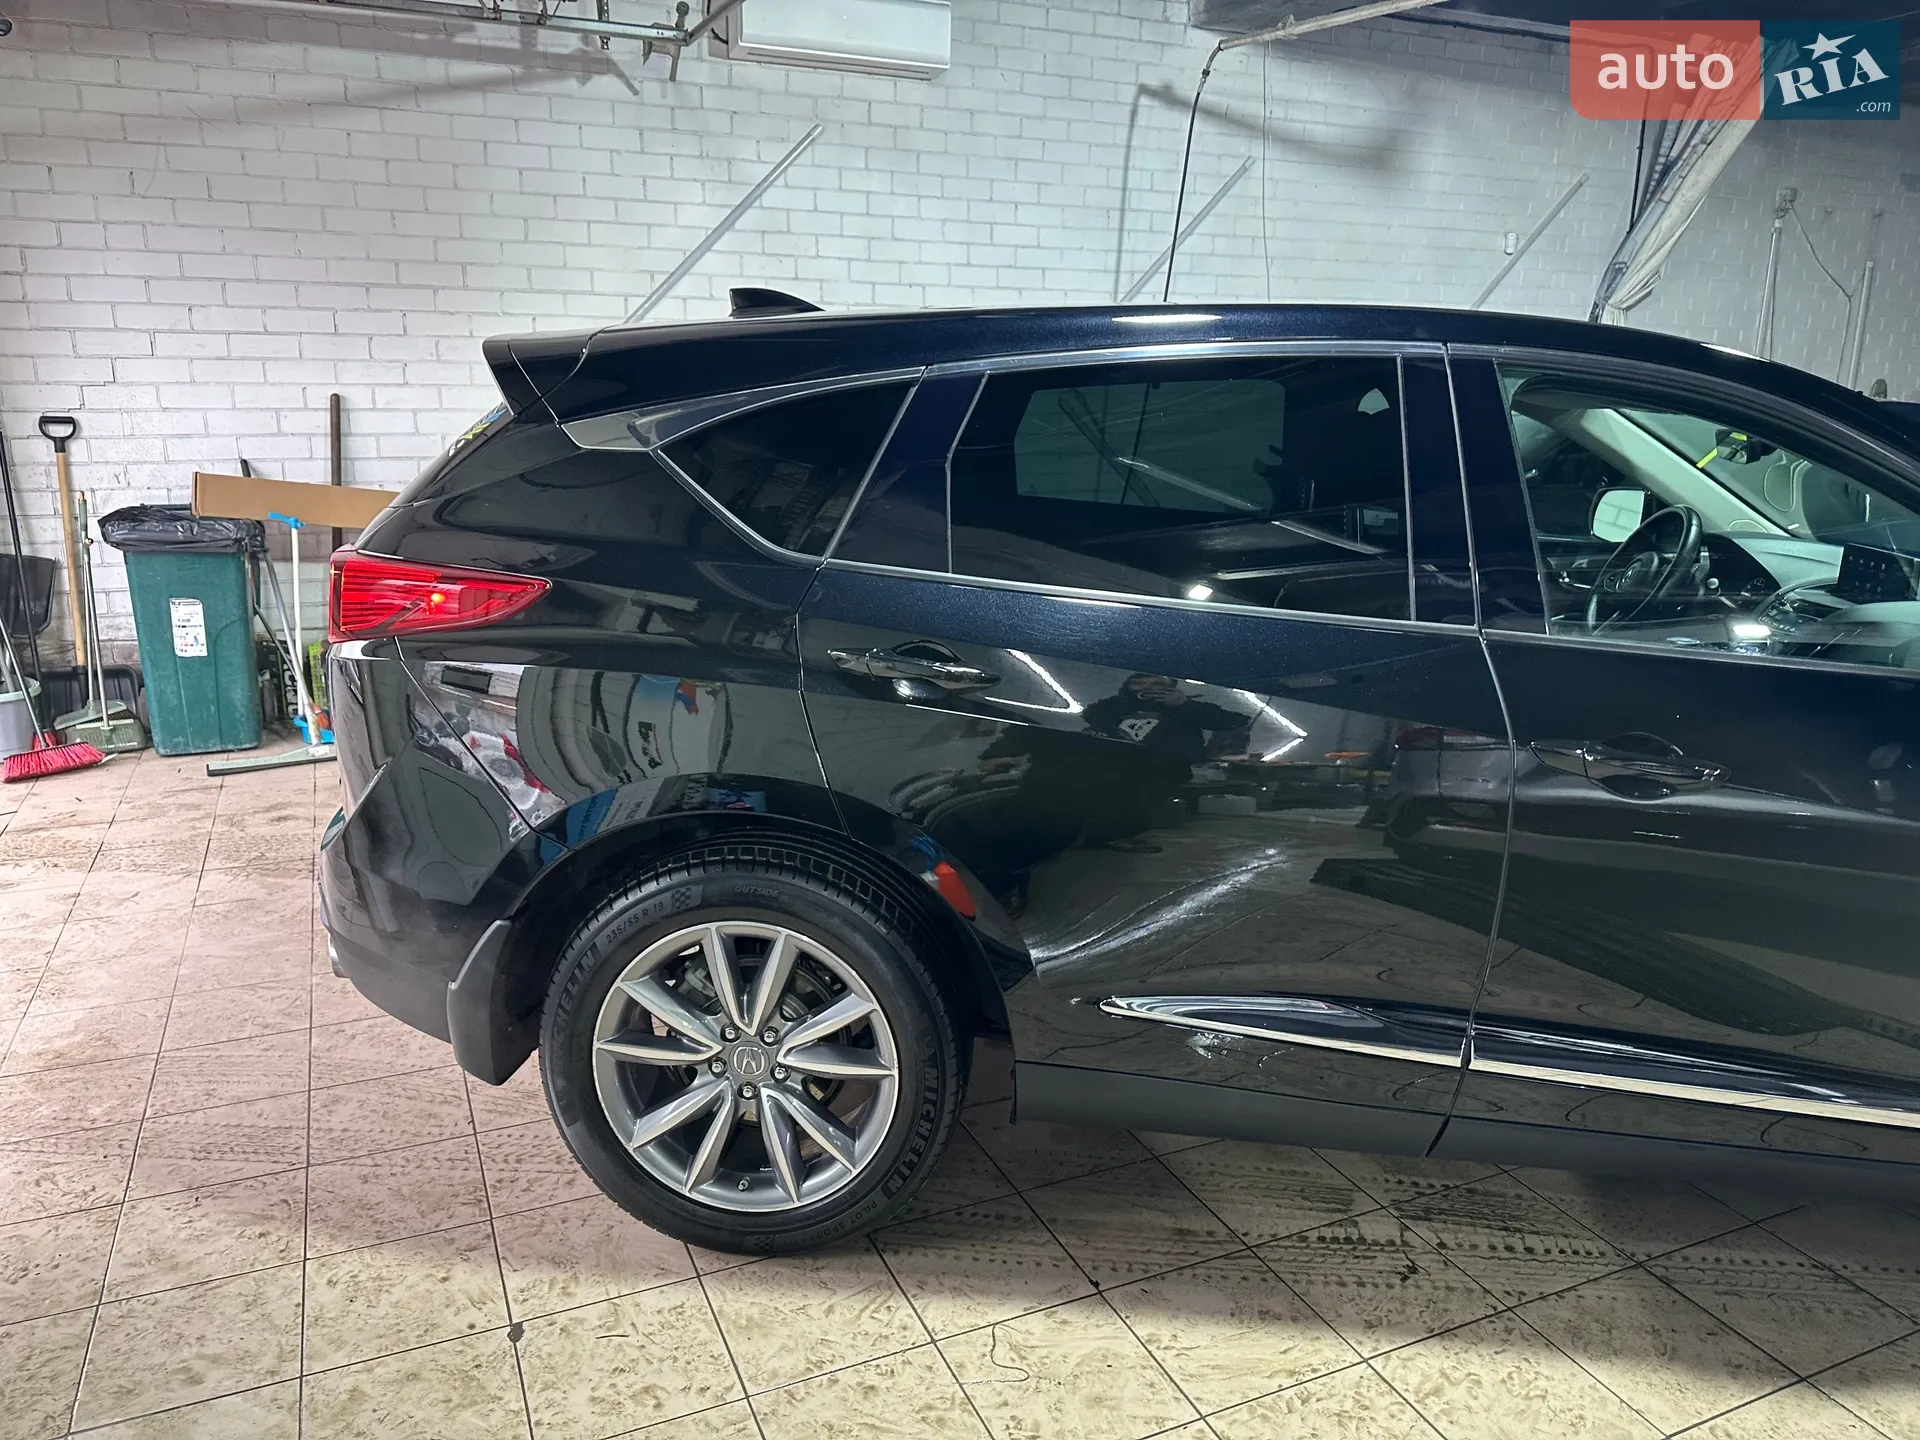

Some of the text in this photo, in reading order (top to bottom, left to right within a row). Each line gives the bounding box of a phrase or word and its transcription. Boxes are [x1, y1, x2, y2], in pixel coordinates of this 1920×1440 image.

[606, 901, 664, 945] 235/55 R 19
[734, 885, 781, 898] OUTSIDE
[551, 948, 597, 1074] ICHELIN
[886, 1067, 939, 1193] MICHELIN
